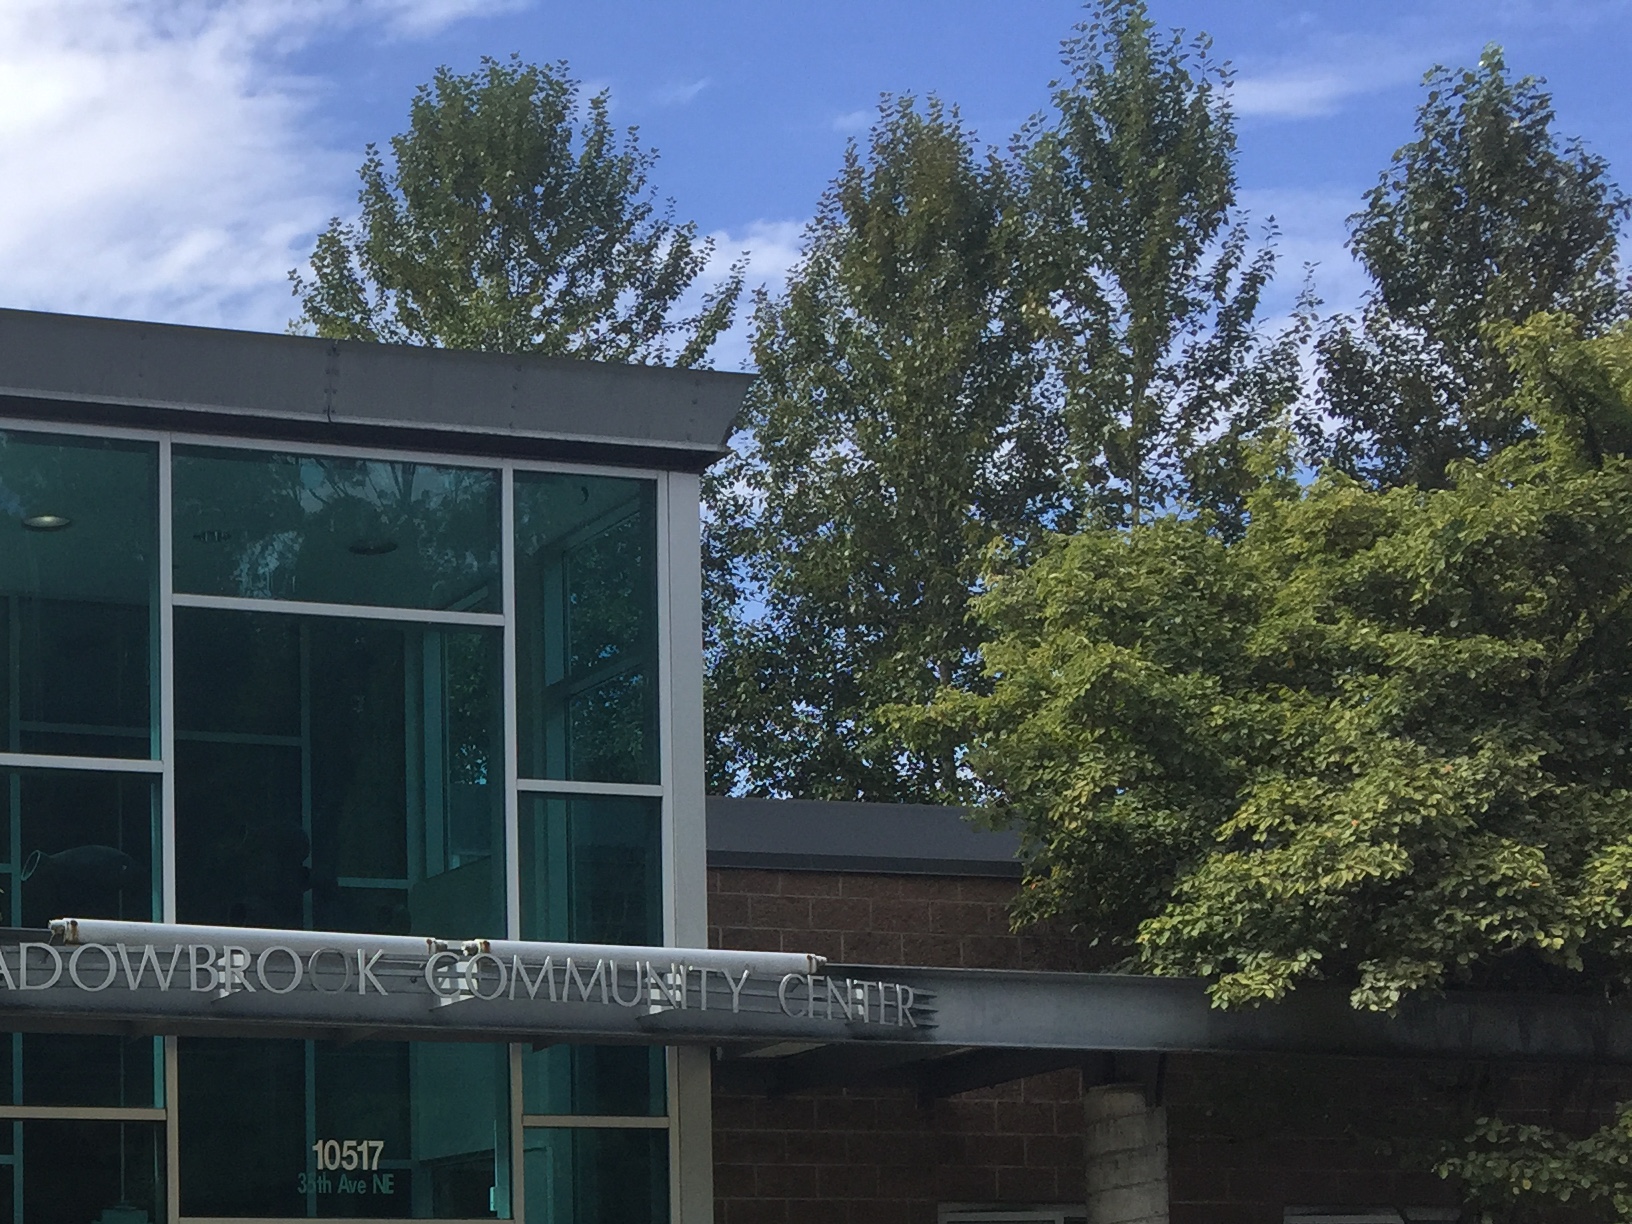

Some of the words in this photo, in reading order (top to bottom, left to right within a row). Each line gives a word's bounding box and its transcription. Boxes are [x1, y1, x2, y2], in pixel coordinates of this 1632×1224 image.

[424, 951, 751, 1014] COMMUNITY
[778, 973, 918, 1028] CENTER
[311, 1139, 385, 1171] 10517
[297, 1172, 332, 1194] 35th
[337, 1173, 367, 1194] Ave
[372, 1173, 395, 1195] NE
